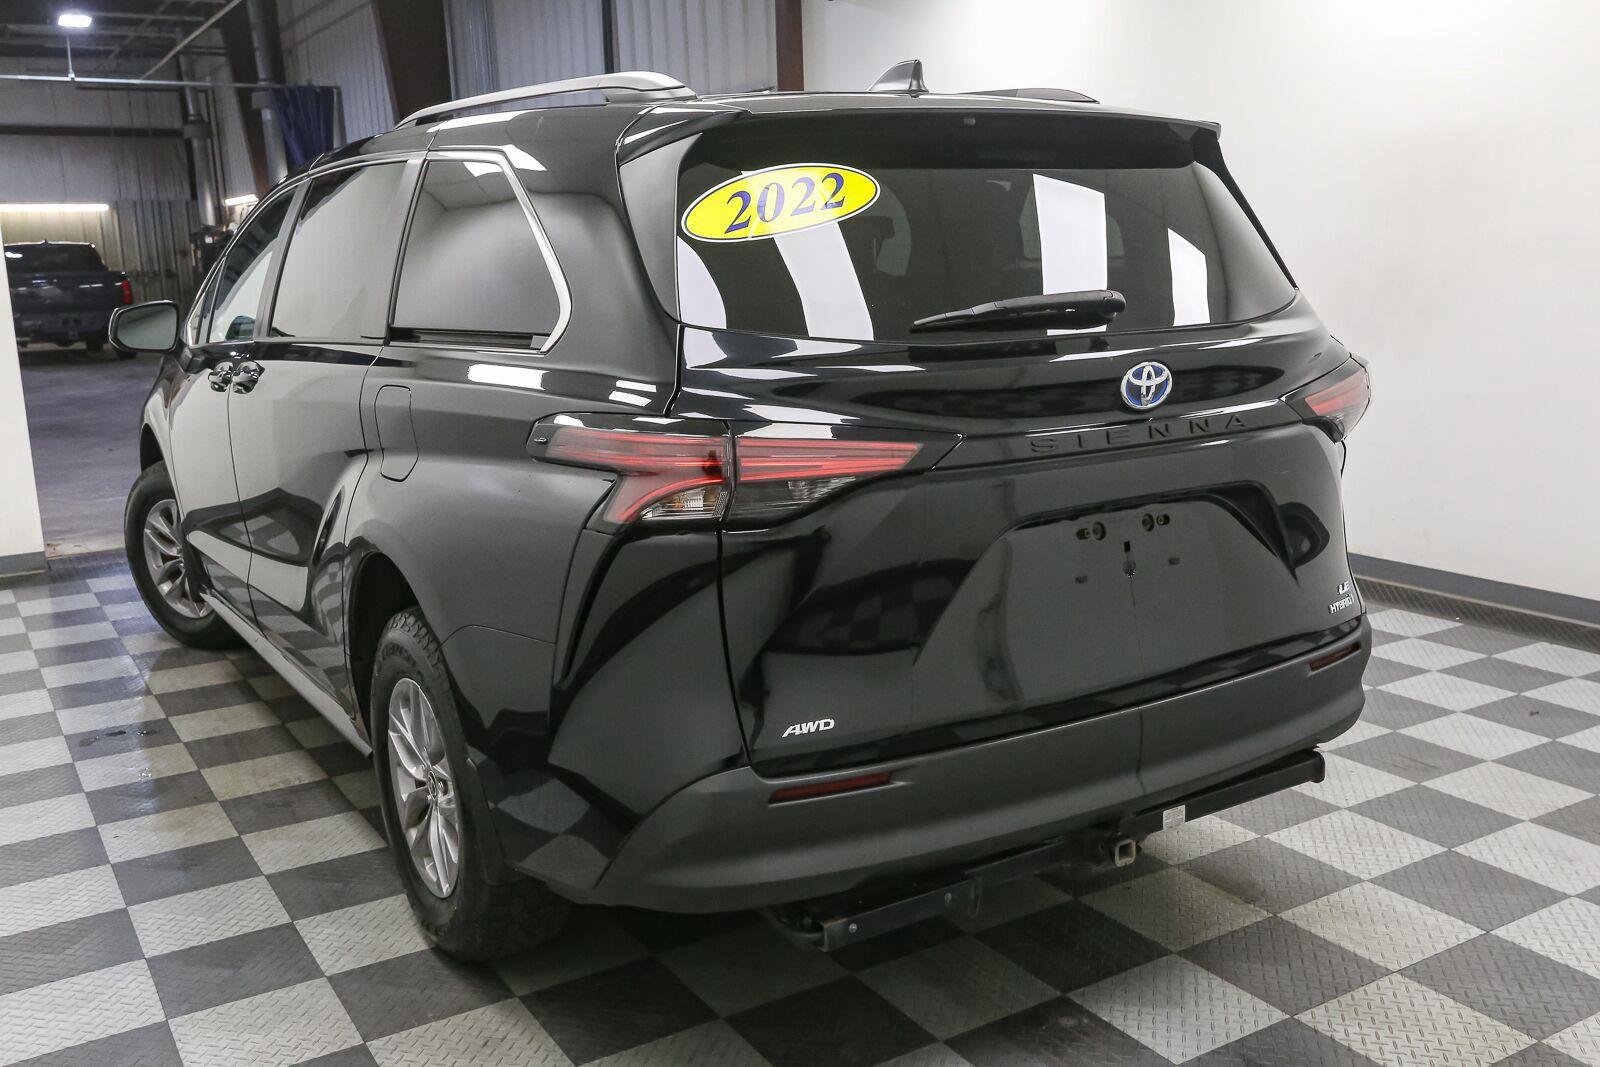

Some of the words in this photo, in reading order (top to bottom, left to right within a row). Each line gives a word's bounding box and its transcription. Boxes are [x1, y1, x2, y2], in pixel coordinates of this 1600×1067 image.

[724, 172, 846, 234] 2022
[1030, 413, 1246, 453] SIENNA
[1337, 580, 1350, 595] LE
[1328, 594, 1355, 614] HYBRID
[781, 718, 835, 738] AWD
